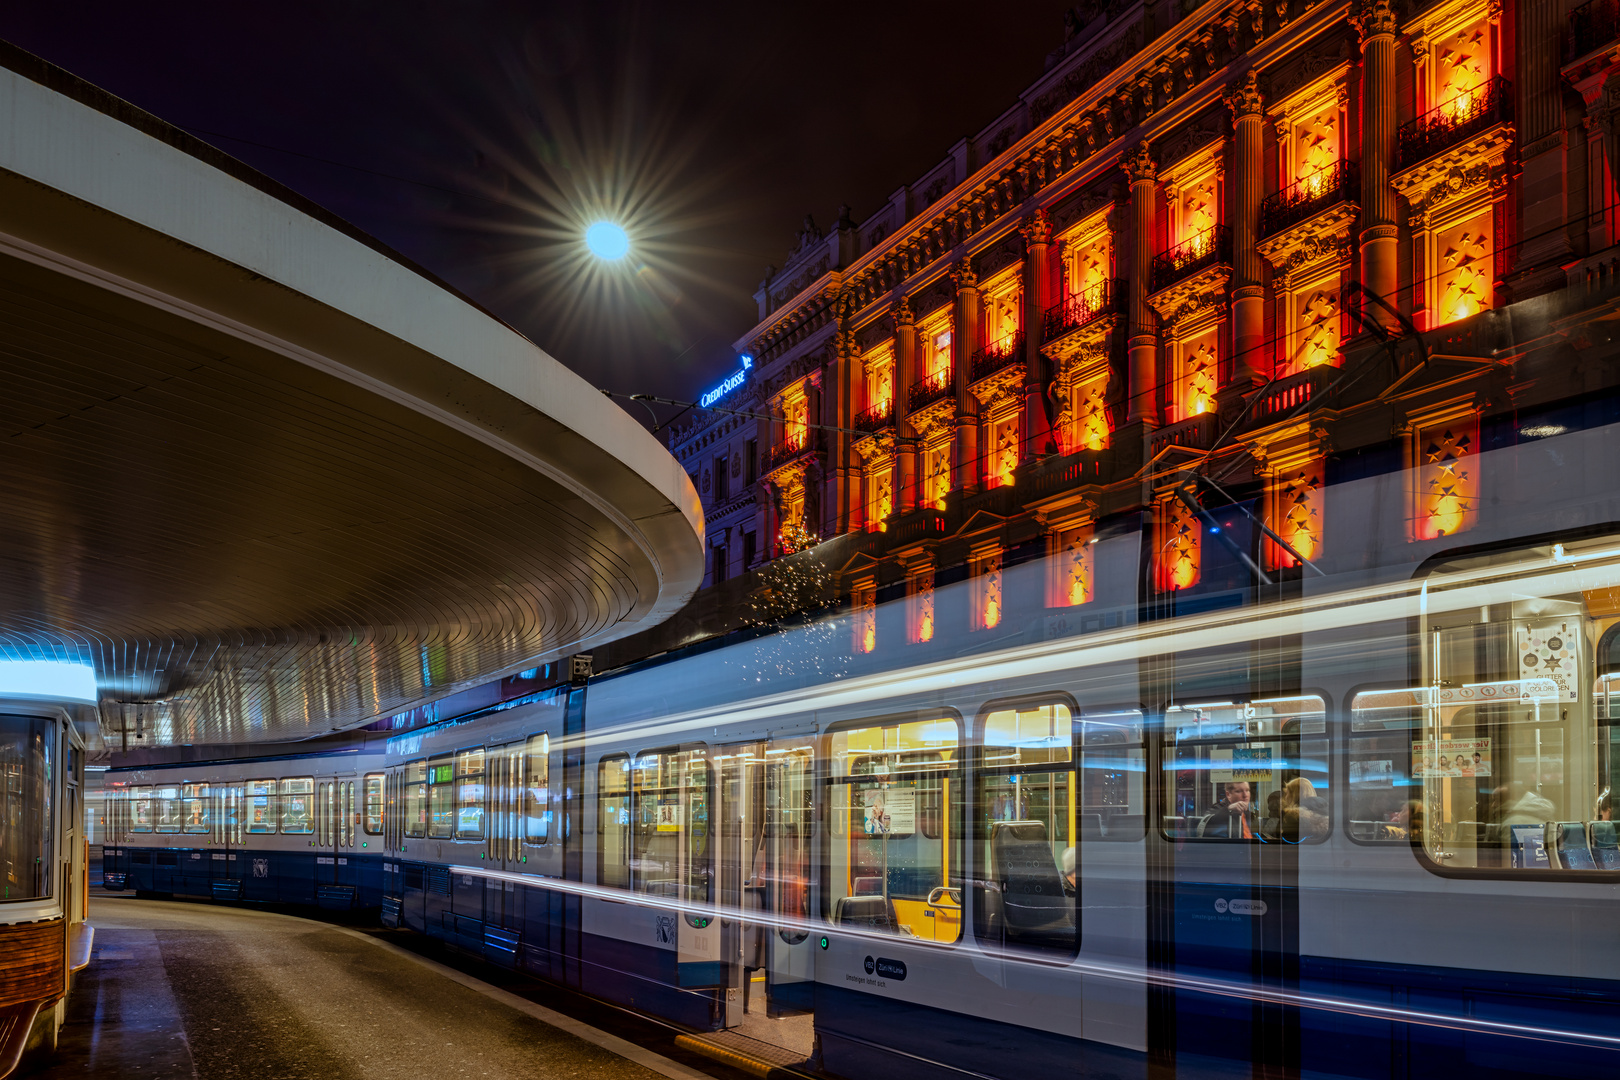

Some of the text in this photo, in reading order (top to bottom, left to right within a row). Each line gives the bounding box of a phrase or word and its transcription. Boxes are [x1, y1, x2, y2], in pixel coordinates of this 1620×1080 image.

[701, 370, 745, 407] CREDIT SUISSE
[865, 961, 874, 969] VBZ
[846, 974, 865, 984] Umsteigen
[866, 977, 876, 985] lohnt
